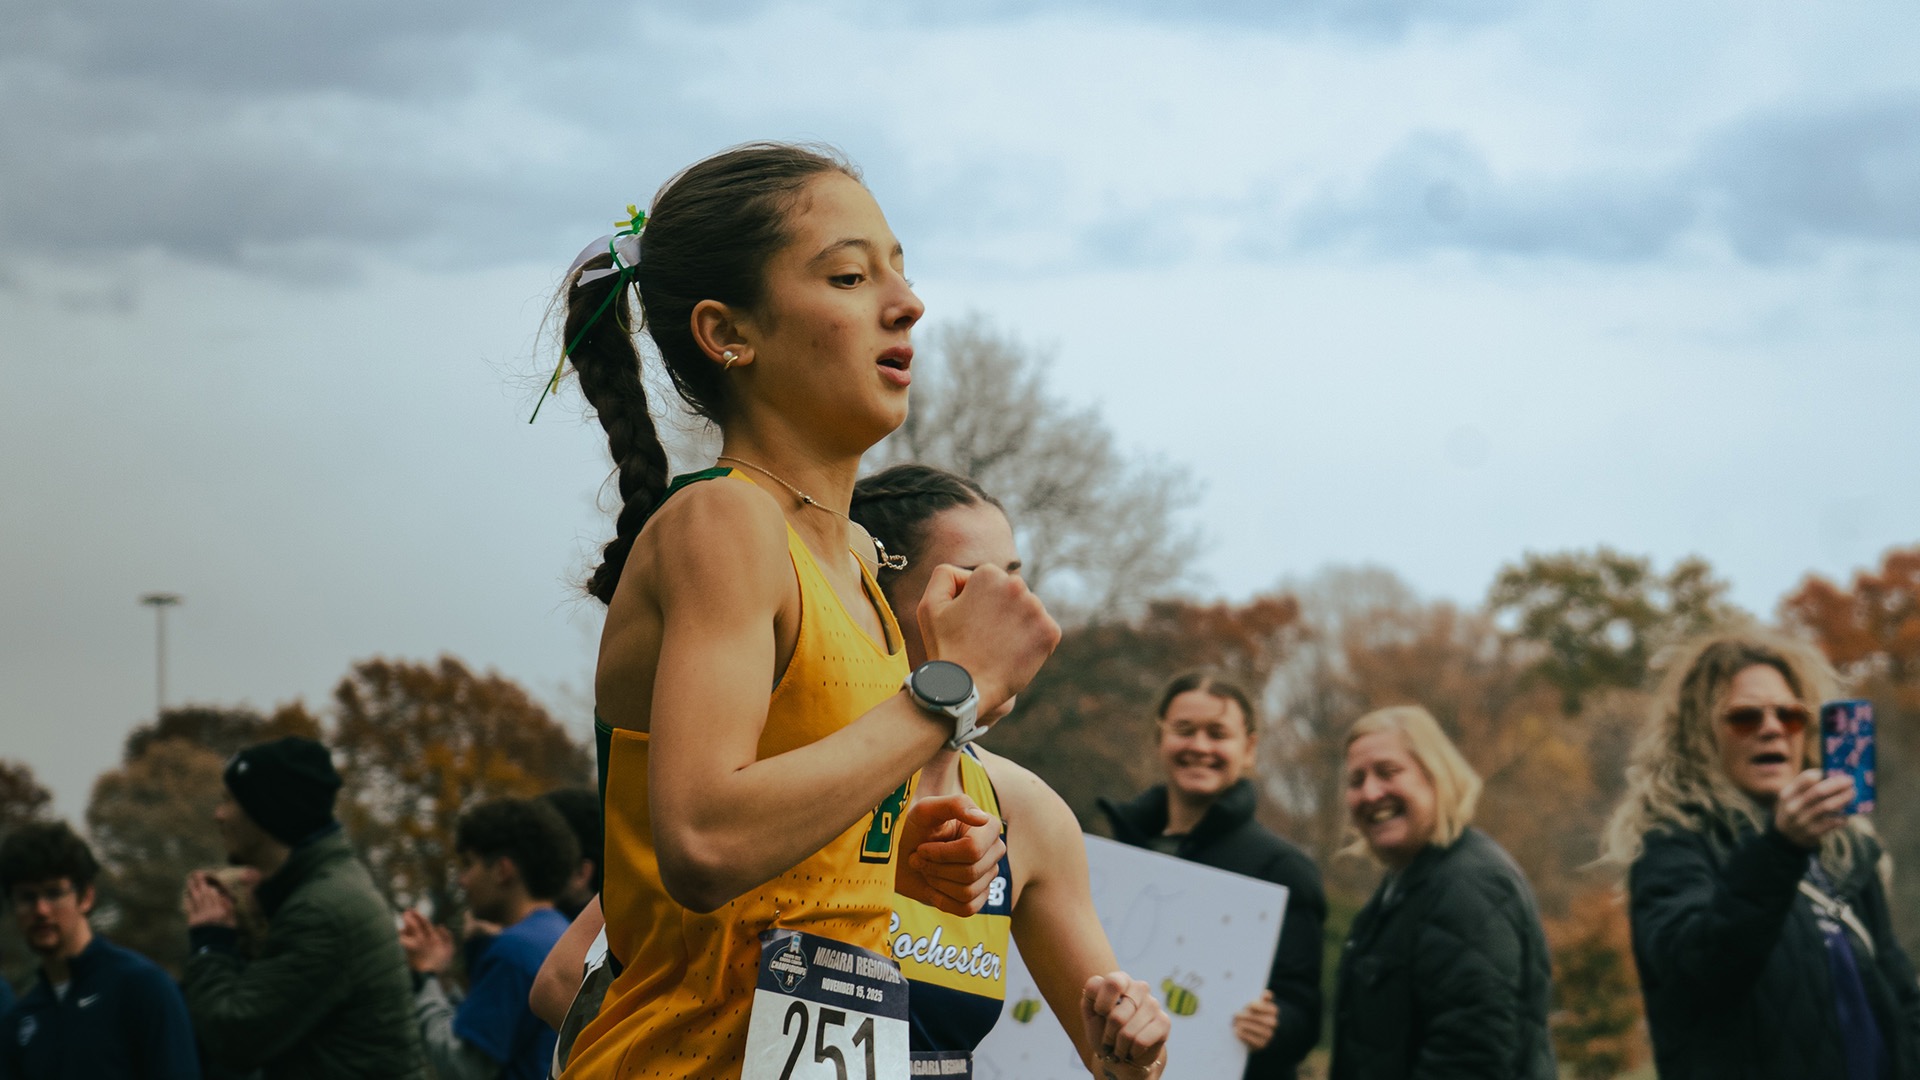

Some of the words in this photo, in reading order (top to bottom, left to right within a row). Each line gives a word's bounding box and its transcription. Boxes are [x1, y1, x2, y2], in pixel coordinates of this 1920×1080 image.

[988, 876, 1007, 906] B
[813, 946, 853, 974] NIAGARA
[856, 954, 901, 984] REGIONAL
[821, 978, 855, 997] NOVEMBER
[866, 987, 883, 1002] 2025
[779, 1001, 876, 1080] 251
[910, 1060, 940, 1075] GARA
